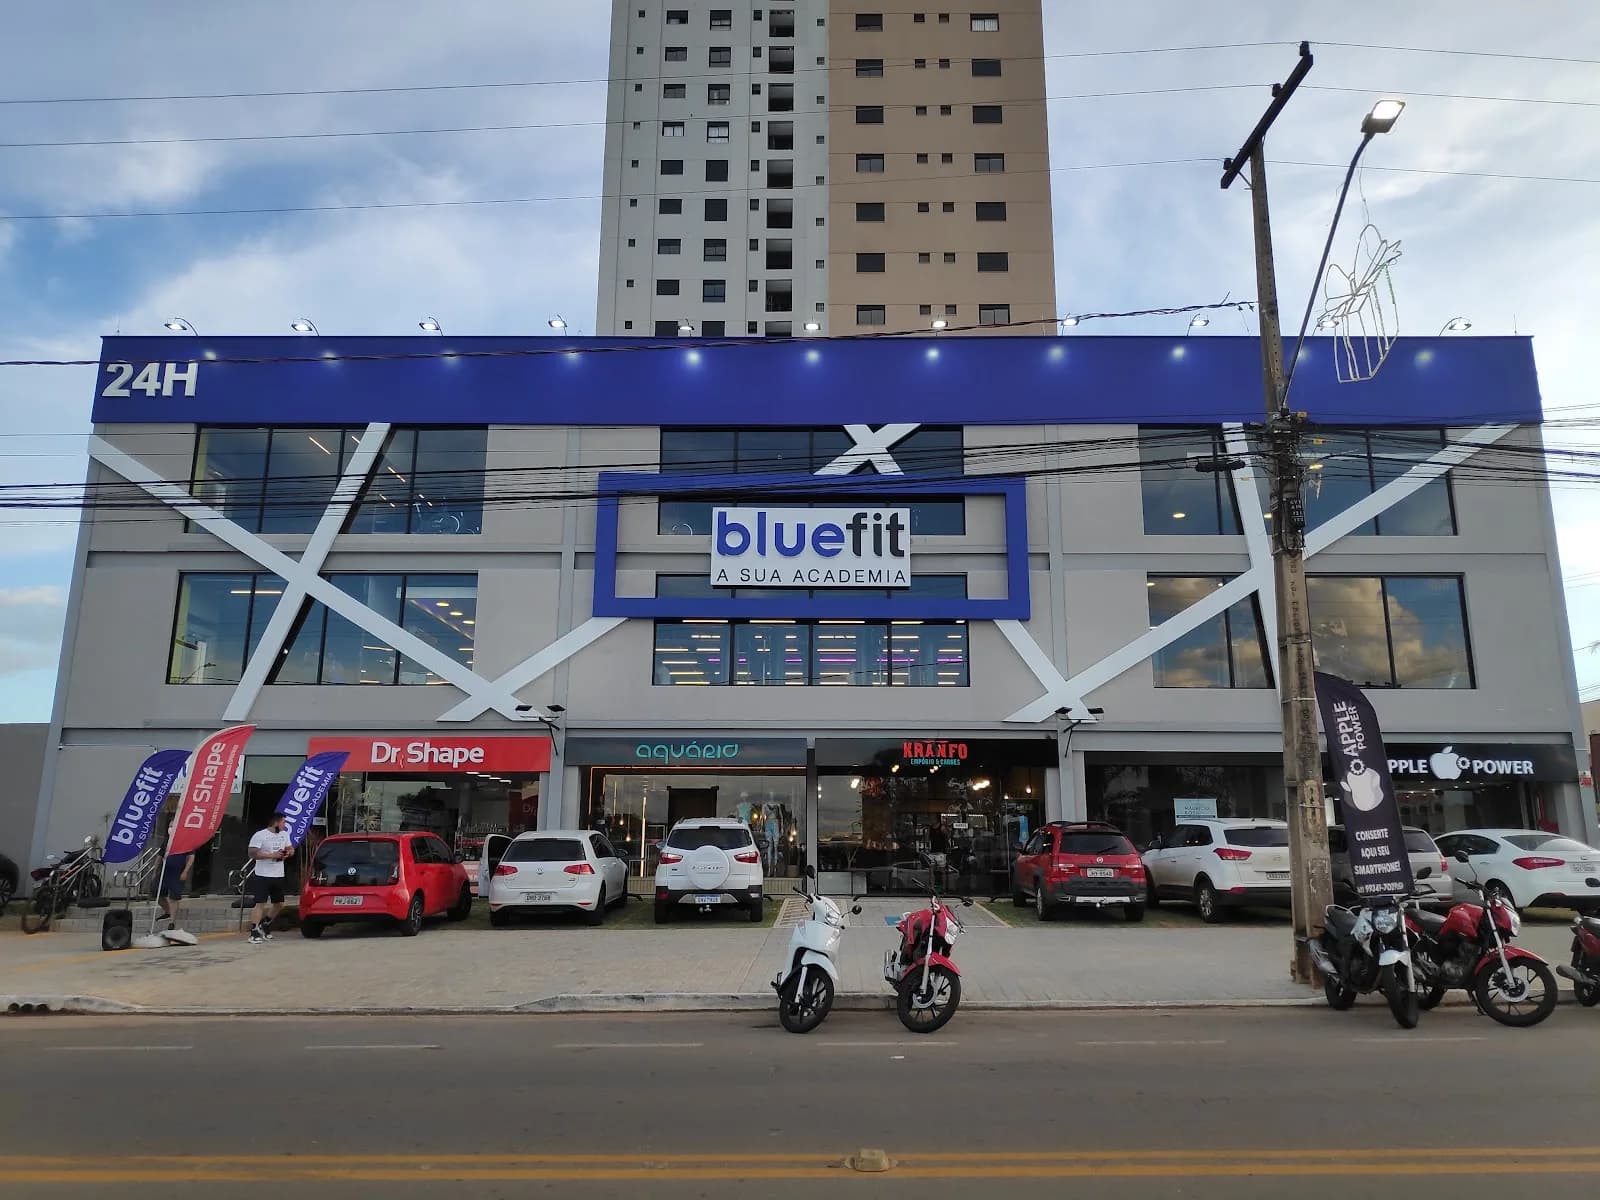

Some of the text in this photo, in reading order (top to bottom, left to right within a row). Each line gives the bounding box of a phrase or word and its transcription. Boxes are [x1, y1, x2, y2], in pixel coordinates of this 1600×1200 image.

[102, 360, 199, 397] 24H
[716, 511, 905, 557] bluefit
[717, 568, 906, 583] A SUA ACADEMIA
[1333, 701, 1359, 757] APPLE
[1348, 705, 1367, 750] POWER
[192, 742, 226, 803] Shape
[371, 741, 485, 769] Dr Shape
[1387, 759, 1534, 775] PPLE POWER
[112, 766, 163, 845] bluefit
[139, 819, 151, 841] SUA
[147, 773, 175, 821] ACADEMIA
[305, 772, 335, 817] ACADEMIA
[184, 806, 207, 829] Dr
[1355, 828, 1389, 841] CONSERTE
[1360, 845, 1390, 859] AQUI SEU
